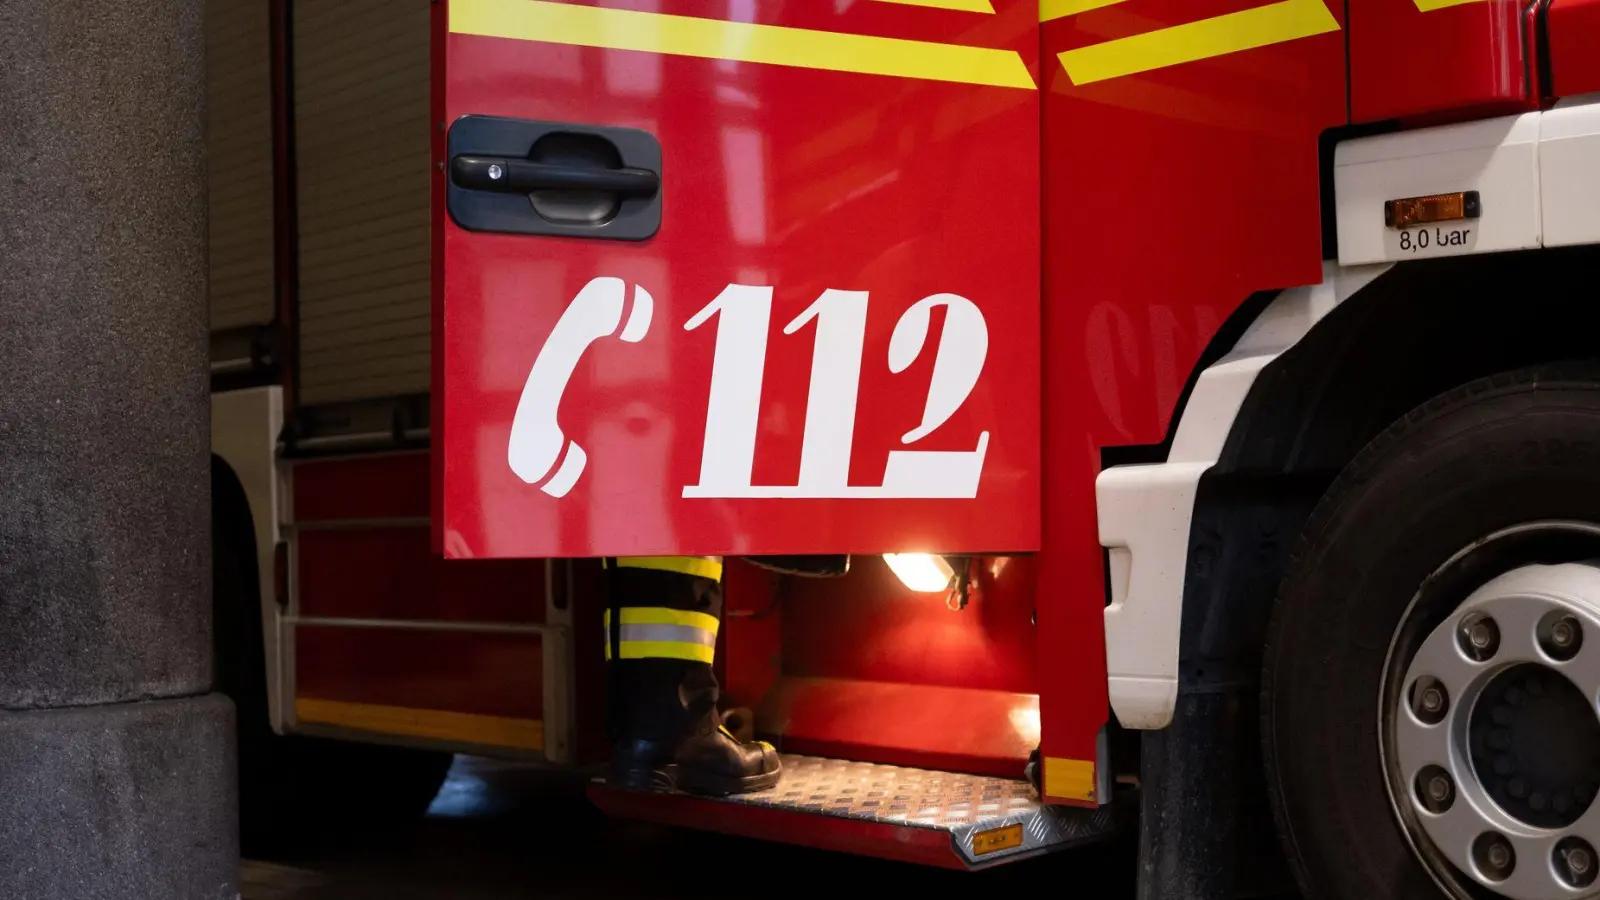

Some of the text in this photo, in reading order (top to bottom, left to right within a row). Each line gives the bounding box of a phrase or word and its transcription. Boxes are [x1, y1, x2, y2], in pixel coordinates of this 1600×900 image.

[1400, 228, 1470, 252] 8,0 bar
[682, 283, 990, 499] 112
